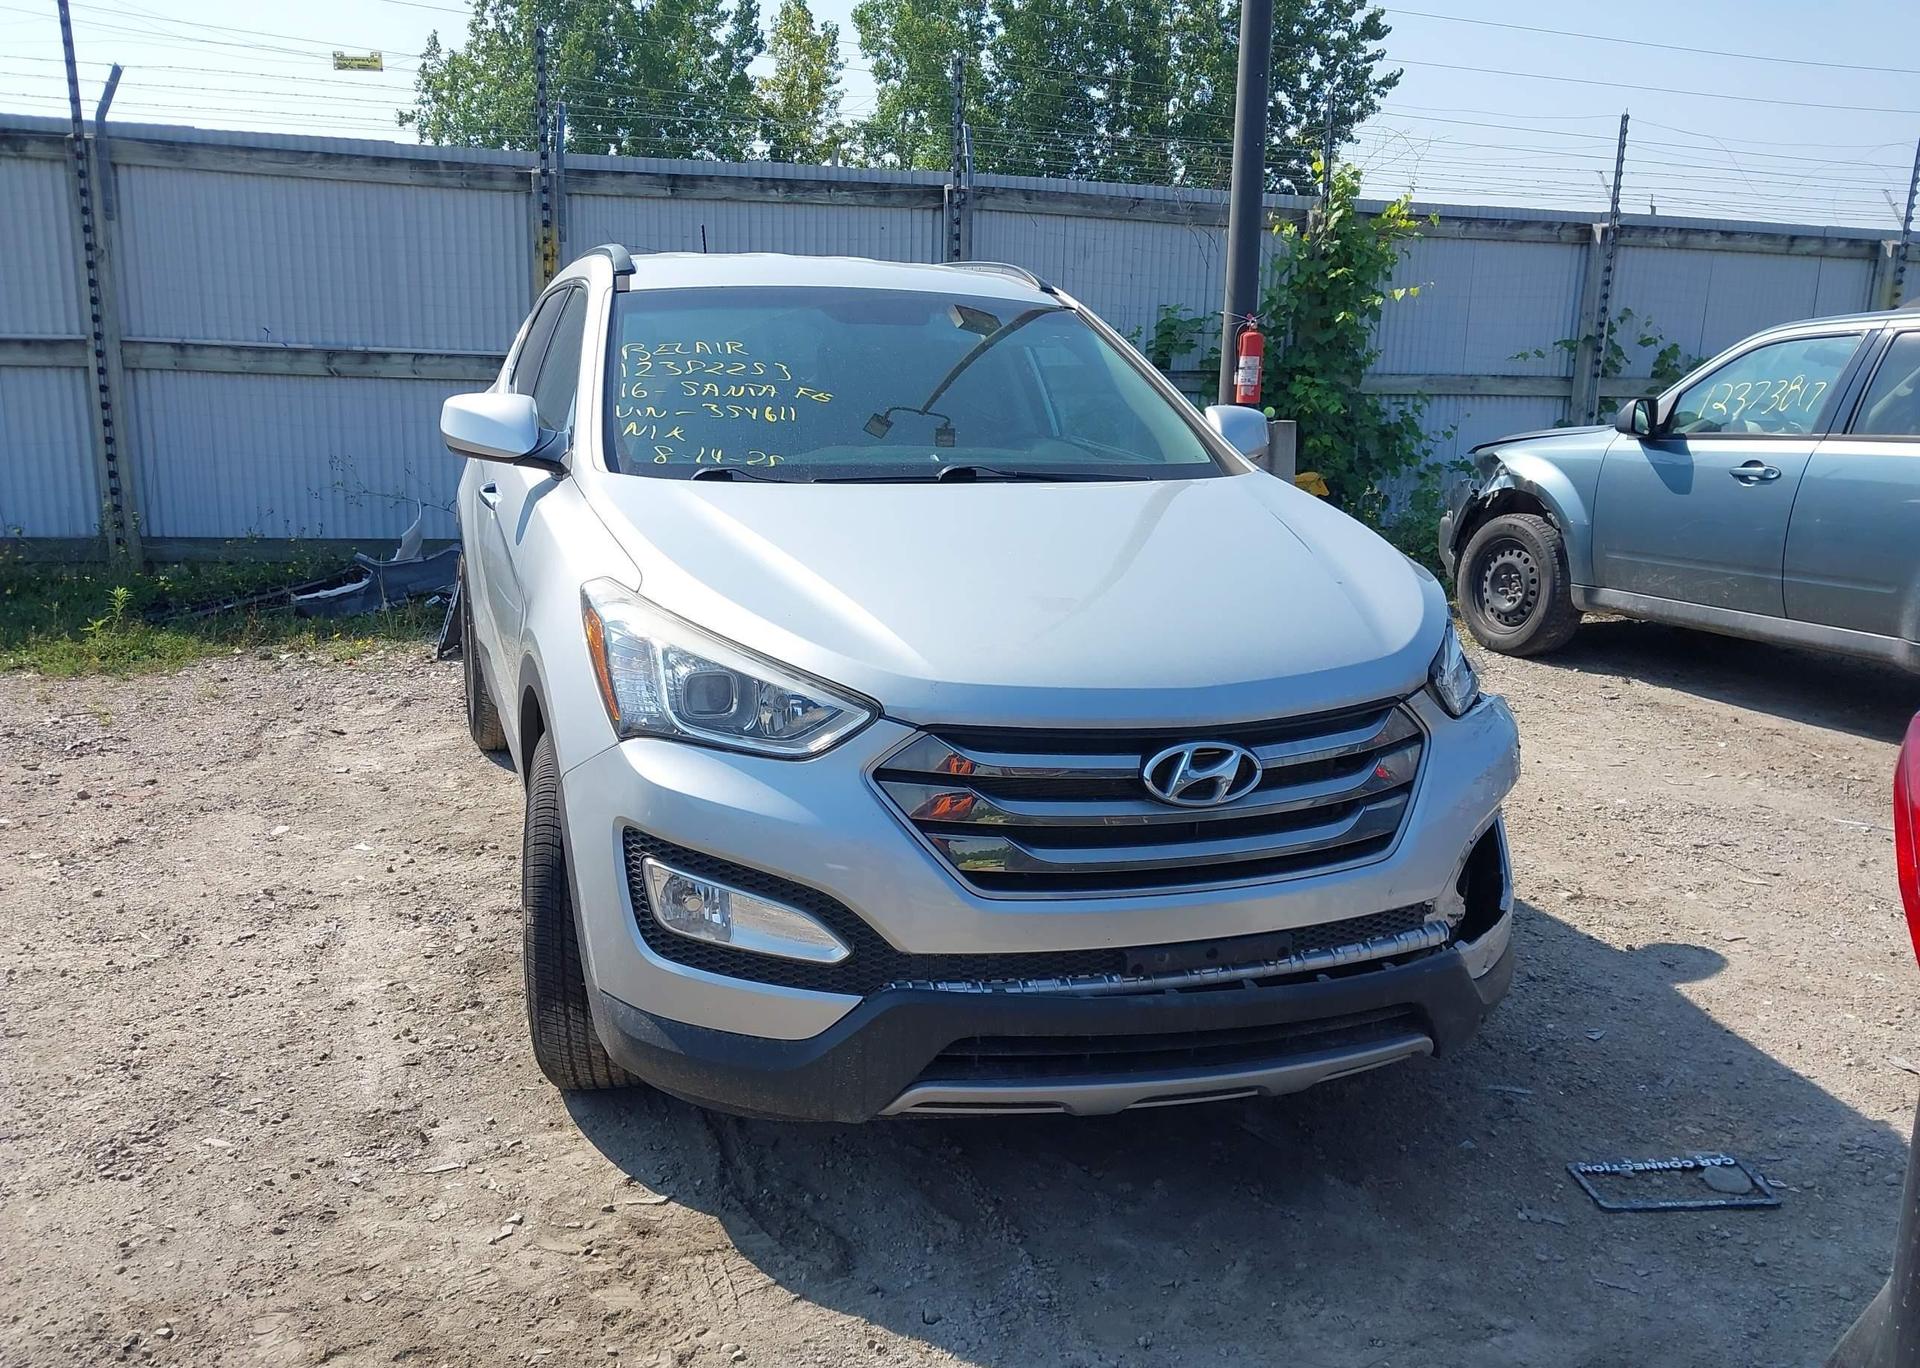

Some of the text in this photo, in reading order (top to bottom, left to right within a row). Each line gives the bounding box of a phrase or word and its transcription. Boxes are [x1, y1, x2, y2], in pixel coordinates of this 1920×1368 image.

[680, 381, 779, 398] SANTA
[1578, 1156, 1736, 1173] CAR CONNECTION
